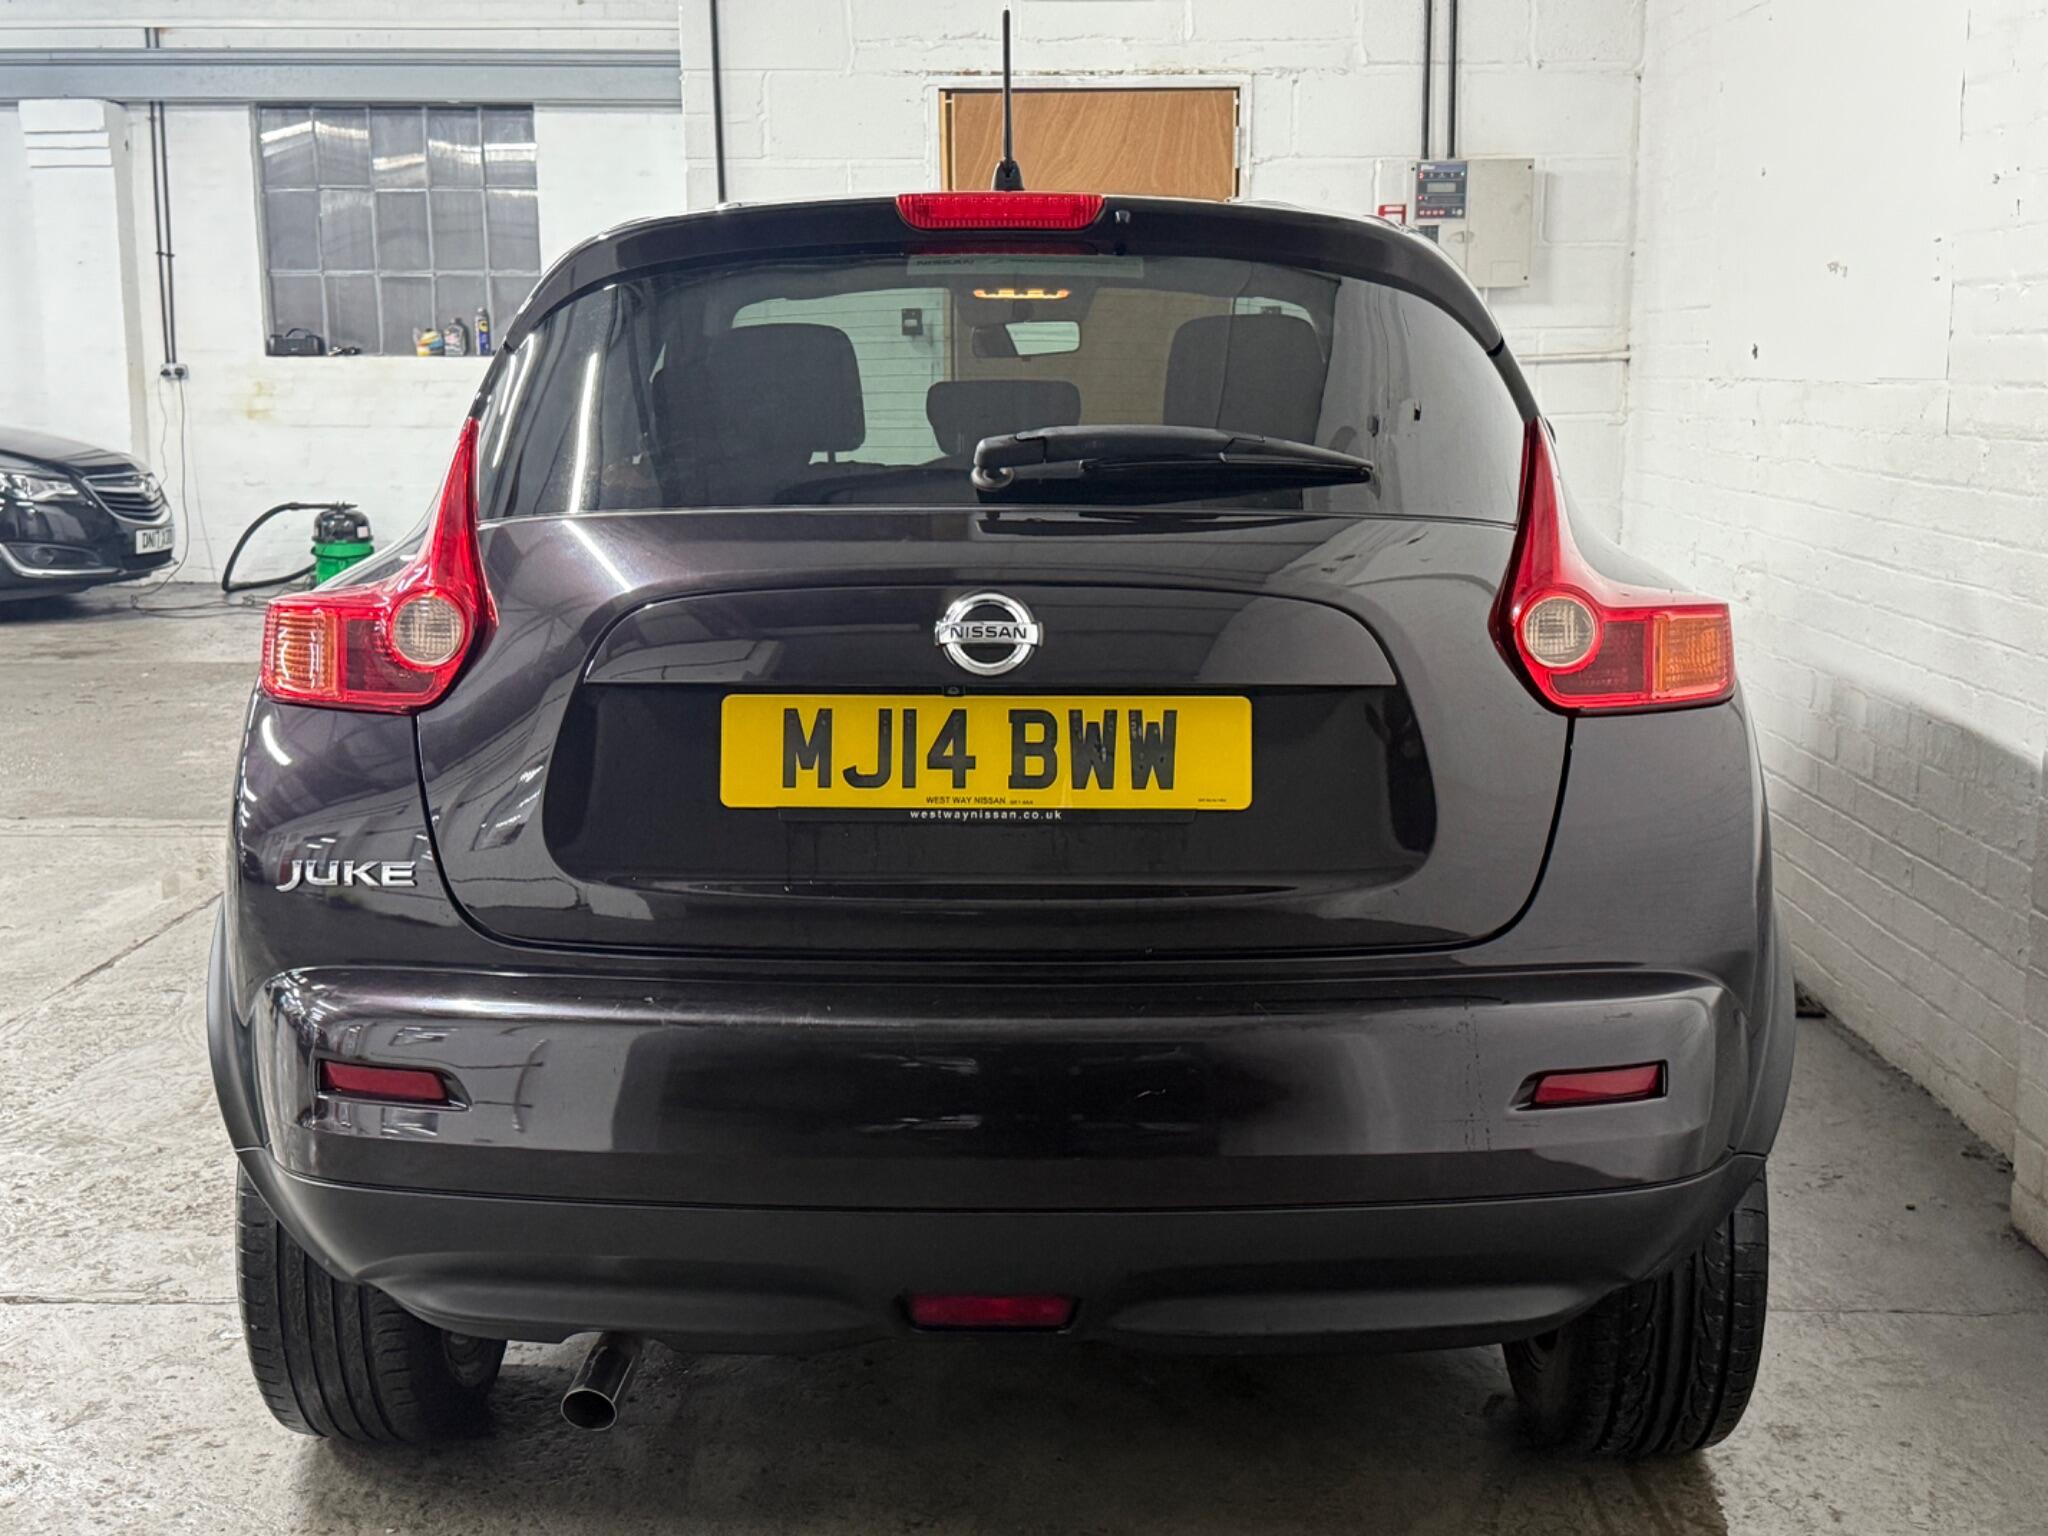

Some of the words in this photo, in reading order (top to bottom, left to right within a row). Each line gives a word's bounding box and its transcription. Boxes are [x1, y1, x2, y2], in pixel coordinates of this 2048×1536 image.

[950, 626, 1027, 639] NISSAN
[782, 708, 976, 789] MJ14
[1008, 709, 1178, 790] BWW
[926, 796, 950, 804] WEST
[952, 796, 973, 804] WAY
[974, 796, 1006, 804] NISSAN
[910, 809, 1062, 822] westwaynissan.co.uk
[275, 859, 417, 893] JUKE
